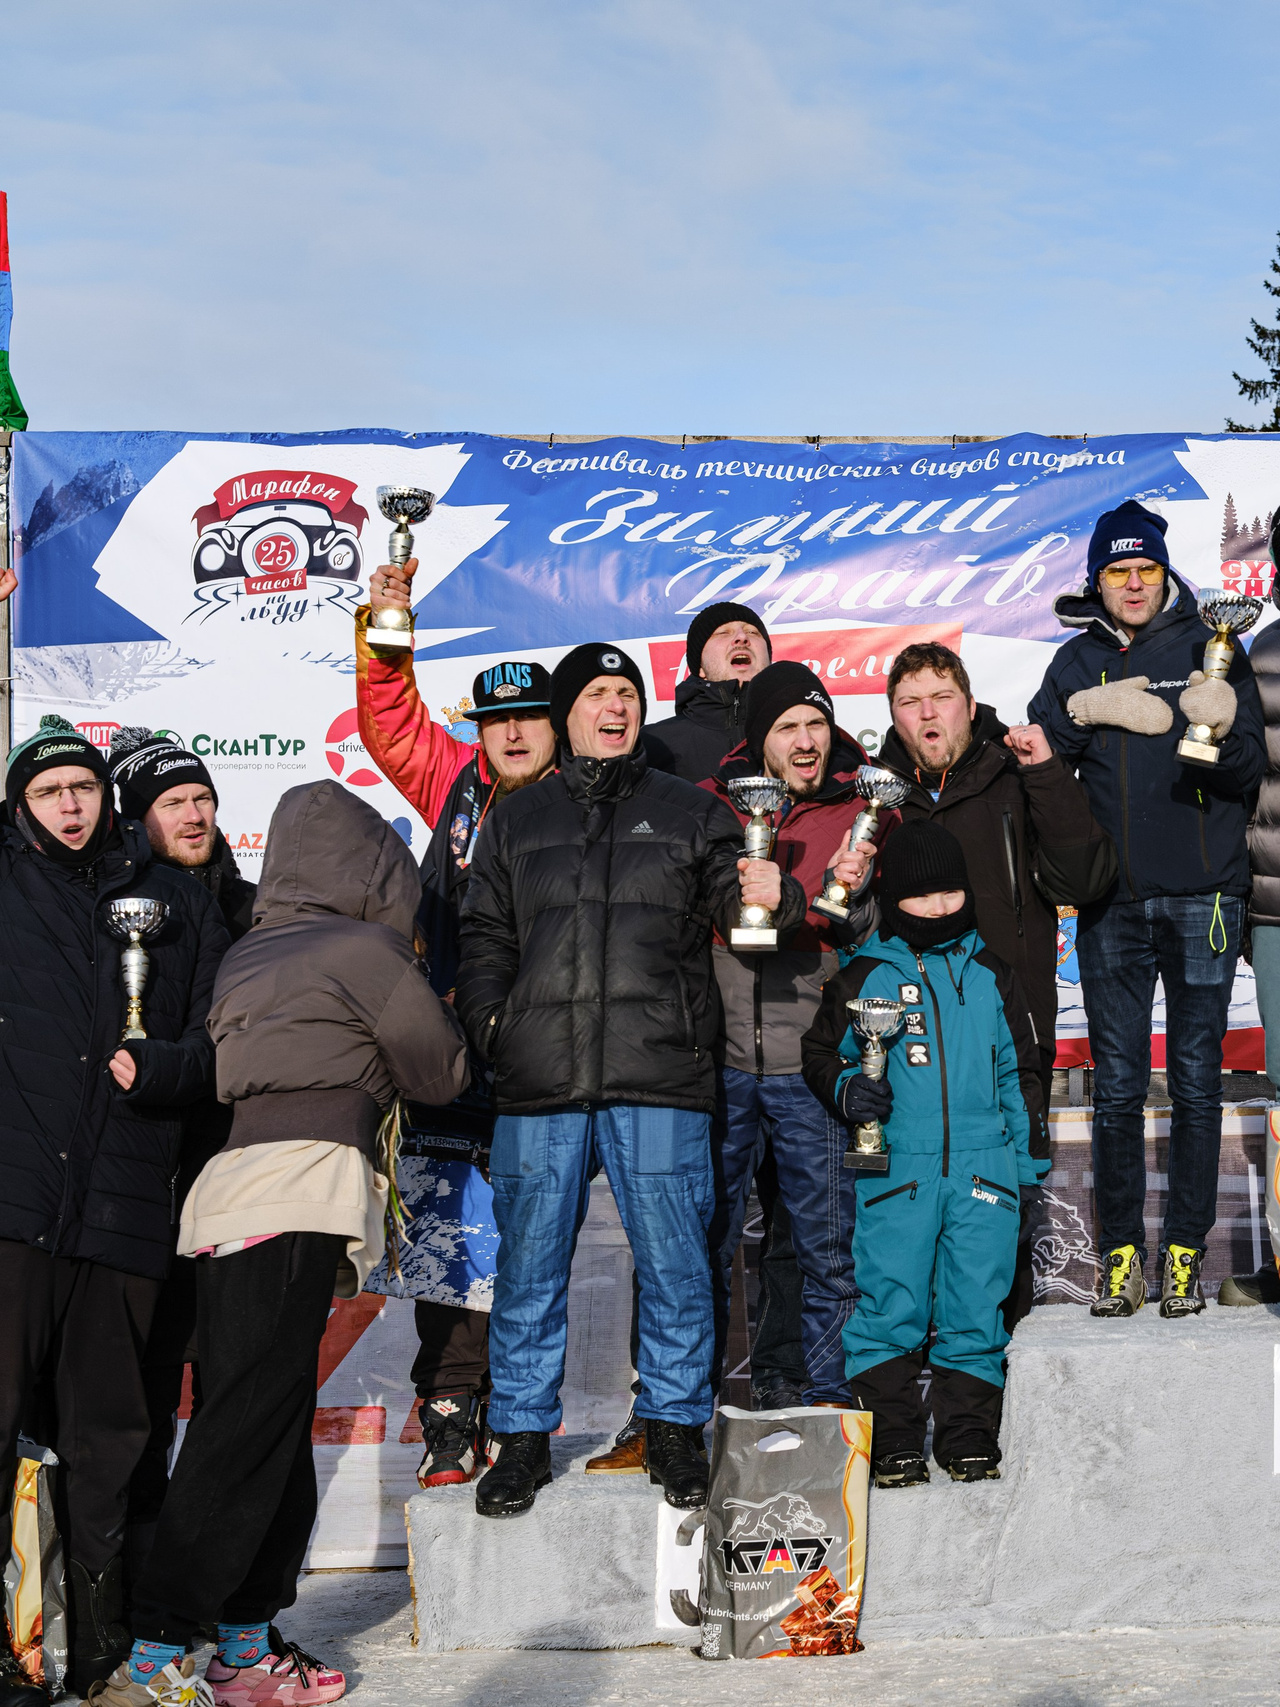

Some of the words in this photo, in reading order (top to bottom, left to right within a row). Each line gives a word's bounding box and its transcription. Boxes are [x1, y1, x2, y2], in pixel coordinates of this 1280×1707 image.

[502, 449, 688, 480] Фестиваль
[695, 459, 901, 482] технических
[910, 448, 1000, 479] видов
[1008, 449, 1126, 473] спорта
[228, 474, 341, 506] Марафон
[549, 484, 1020, 546] Зимний
[260, 540, 292, 566] 25
[251, 570, 303, 591] часов
[665, 534, 1070, 628] Драйв
[1221, 579, 1273, 597] KH
[240, 598, 309, 625] льду
[265, 594, 287, 605] на
[482, 663, 533, 695] VANS
[338, 742, 366, 753] drive
[210, 763, 262, 771] туроператор
[277, 762, 307, 770] России
[725, 1580, 773, 1591] GERMANY
